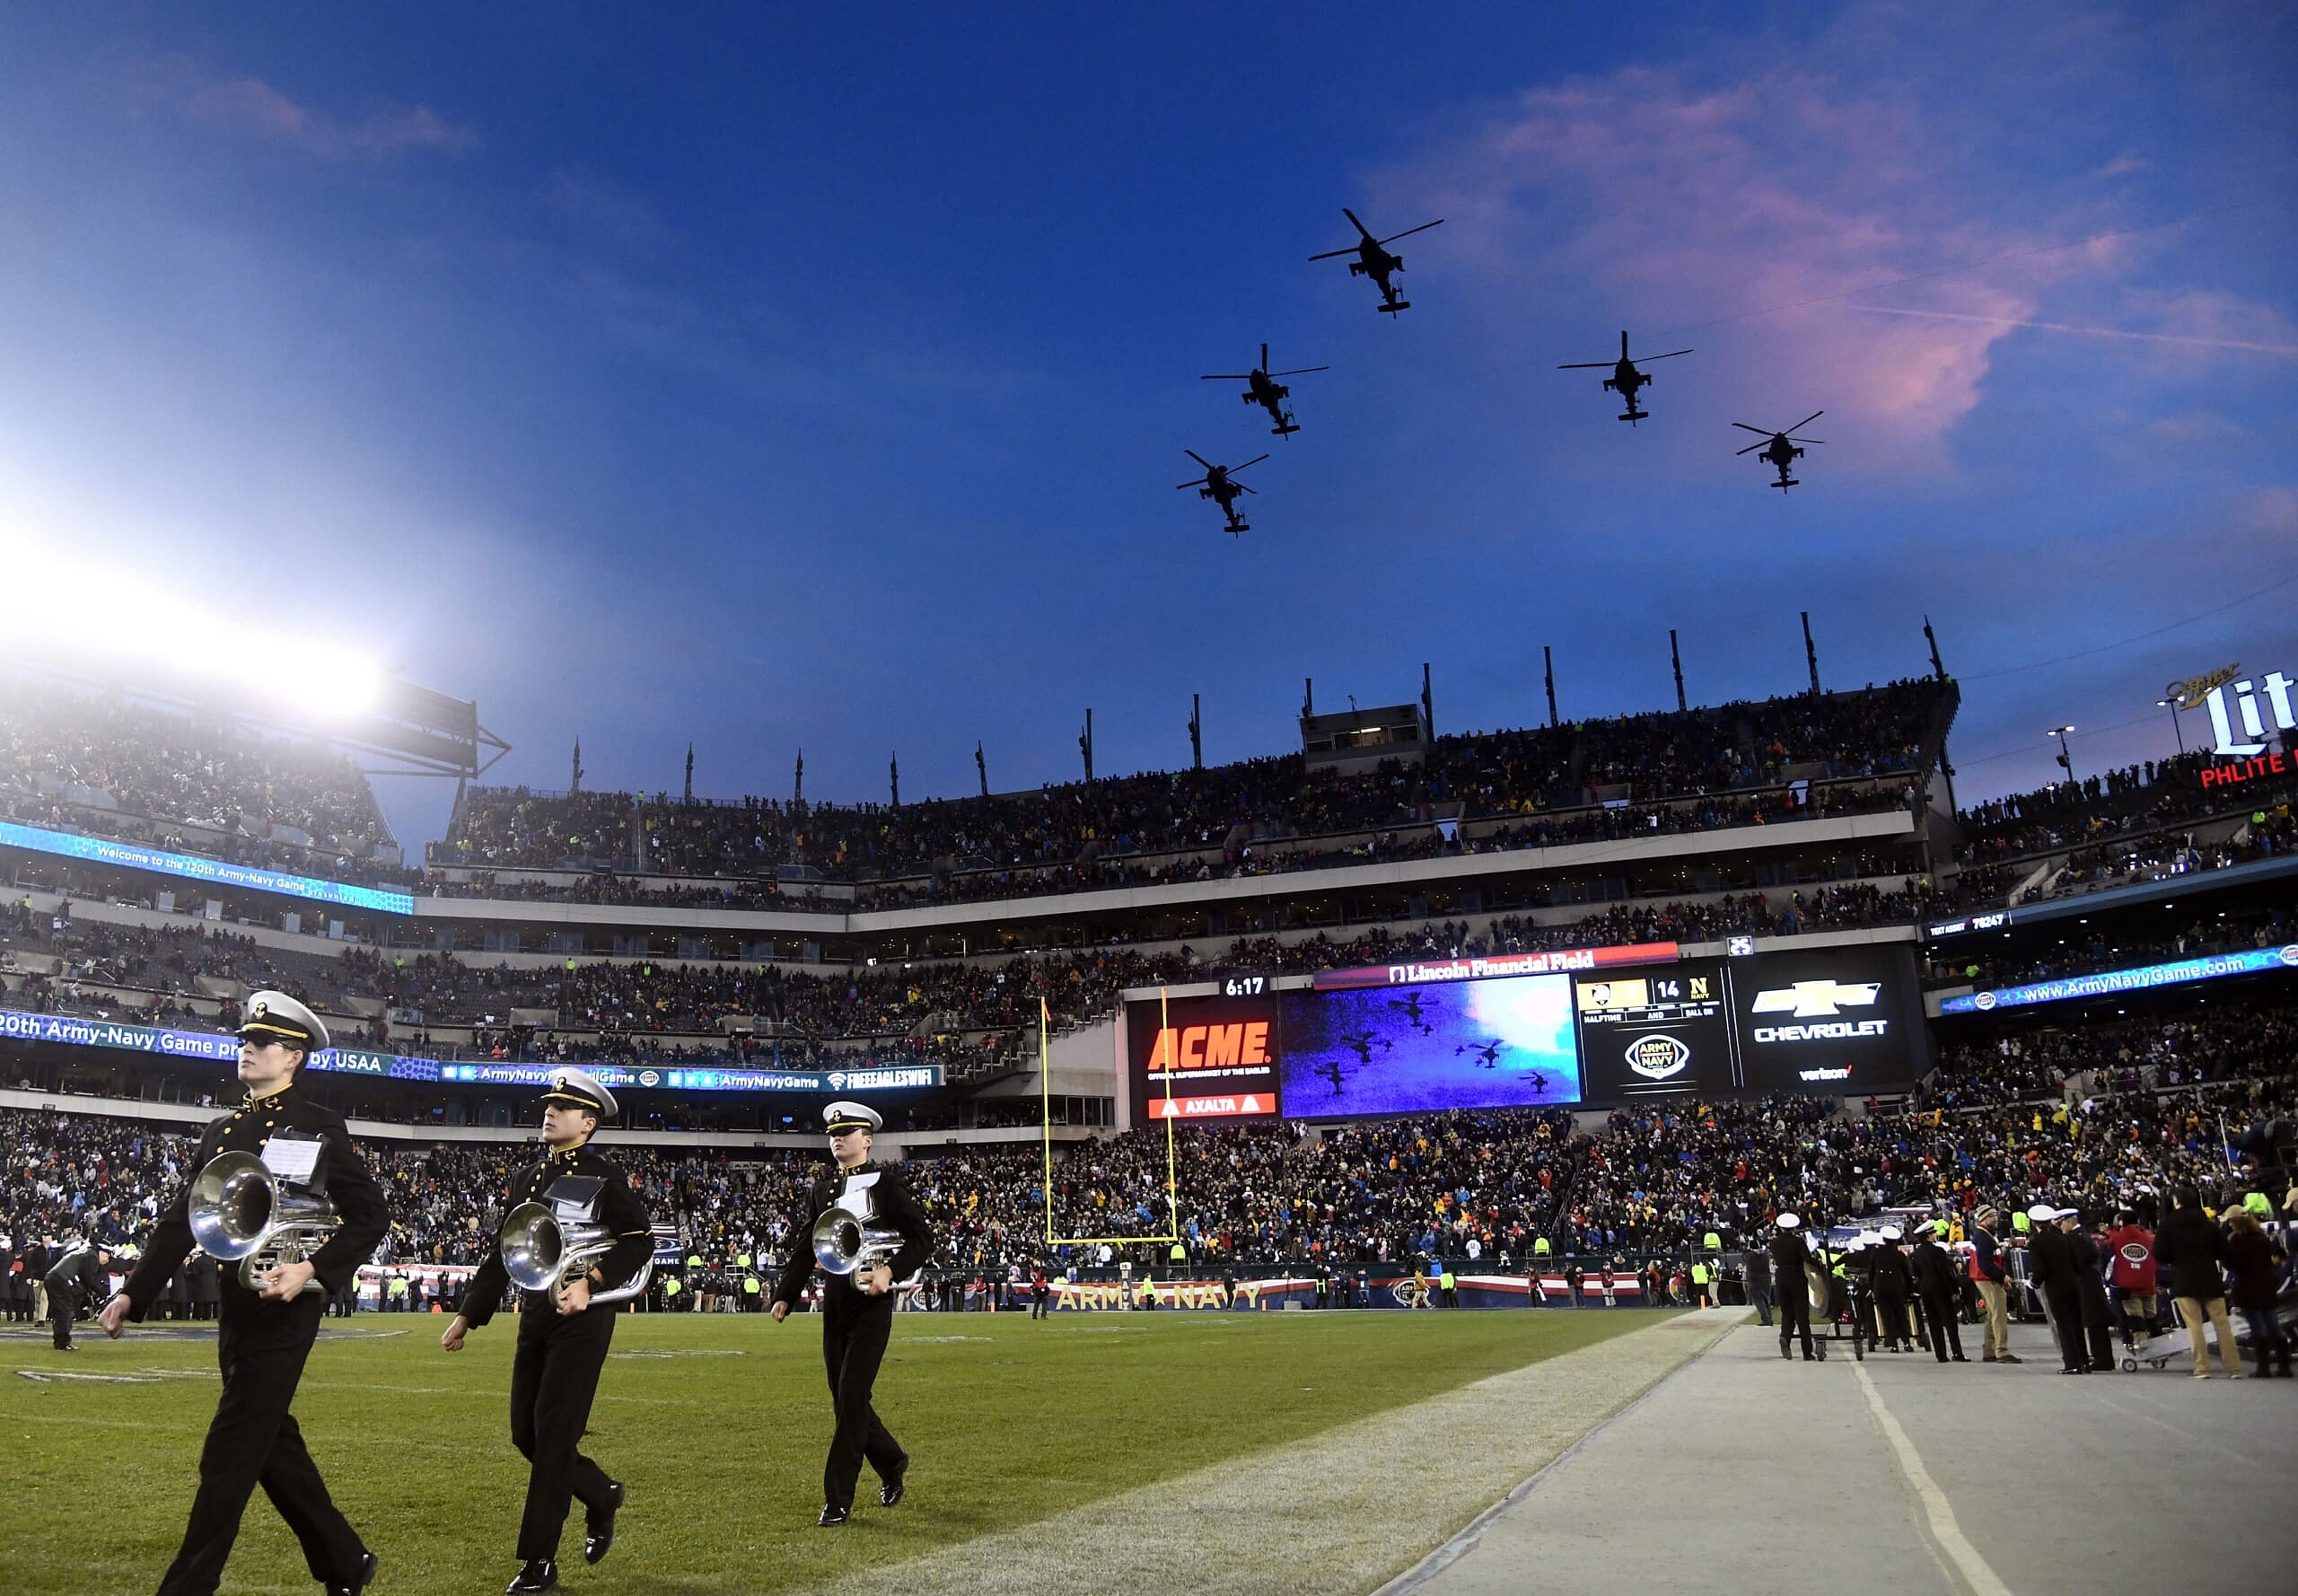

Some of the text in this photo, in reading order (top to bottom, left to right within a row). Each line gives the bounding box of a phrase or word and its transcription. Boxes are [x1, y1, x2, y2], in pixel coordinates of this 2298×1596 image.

[2206, 671, 2298, 755] Lit
[2201, 753, 2286, 789] PHLITE
[98, 846, 148, 864] Welcome
[151, 855, 163, 866] to
[166, 857, 183, 870] the
[186, 861, 215, 877] 120th
[218, 868, 274, 888] Army-Navy
[276, 878, 305, 891] Game
[1408, 951, 1594, 981] Lincoln Financial Field
[1226, 977, 1264, 995] 6:17
[1657, 980, 1680, 998] 14
[1689, 978, 1707, 994] N
[2025, 959, 2244, 1002] www.ArmyNavyGame.com
[1583, 1013, 1622, 1023] HALFTIME
[1686, 1009, 1702, 1017] BALL
[47, 1020, 154, 1050] Army-Navy
[161, 1034, 214, 1054] Game
[1754, 1020, 1888, 1042] CHEVROLET
[1640, 1042, 1672, 1054] ARMY
[309, 1051, 382, 1073] by USAA
[1641, 1055, 1673, 1066] NAVY
[722, 1076, 819, 1089] ArmyNavyGame
[847, 1068, 932, 1090] FREEEAGLESWIFI
[1799, 1066, 1848, 1081] verizon
[1186, 1098, 1236, 1114] AXALTA
[1056, 1284, 1263, 1310] ARMY NAVY
